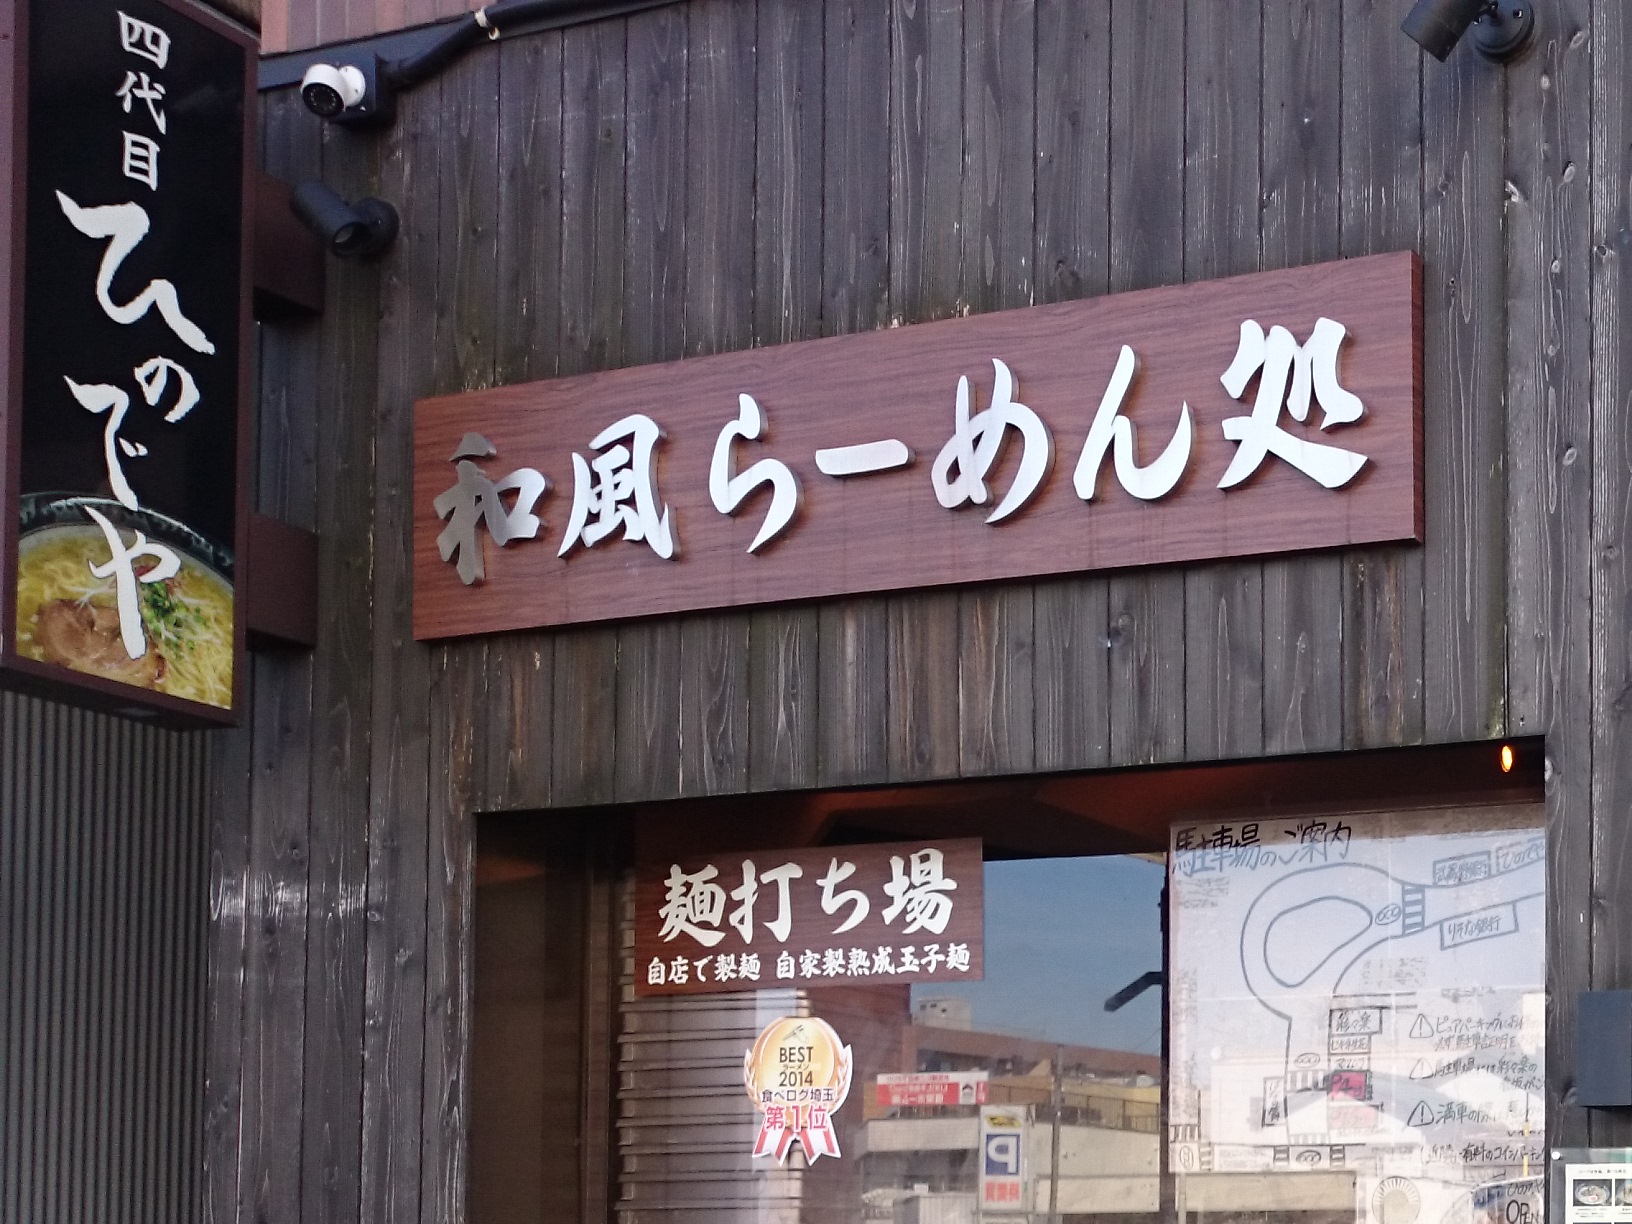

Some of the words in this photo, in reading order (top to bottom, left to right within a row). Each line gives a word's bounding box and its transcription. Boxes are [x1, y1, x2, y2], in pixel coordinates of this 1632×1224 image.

[117, 10, 171, 192] 四代目
[55, 188, 216, 661] ひのでや
[433, 316, 1370, 586] 和風らーめん処
[1173, 822, 1352, 877] 駐車場のご案内
[658, 848, 958, 947] 麺打ち場
[647, 953, 761, 985] 自店で製麺
[776, 942, 971, 979] 自家製熟成玉子麺
[779, 1046, 814, 1063] BEST
[779, 1071, 813, 1087] 2014
[762, 1088, 834, 1102] 食べログ埼玉
[766, 1105, 827, 1130] 第1位
